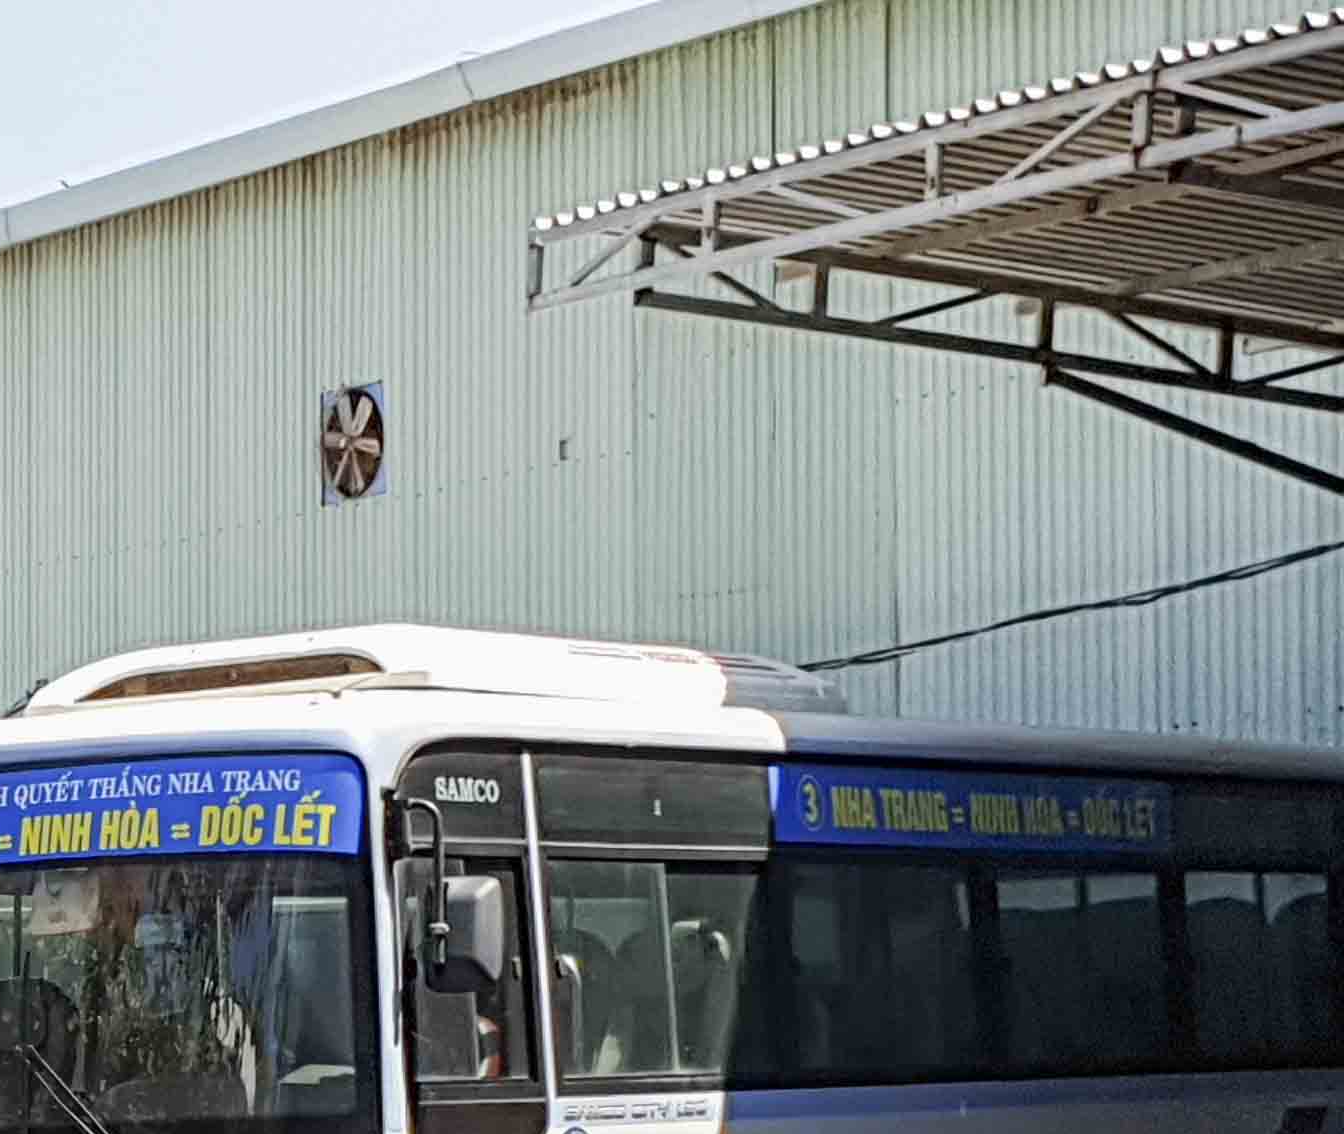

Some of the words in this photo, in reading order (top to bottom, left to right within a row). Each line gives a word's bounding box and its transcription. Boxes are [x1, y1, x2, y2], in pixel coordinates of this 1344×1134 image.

[14, 771, 83, 809] QUYẾT
[89, 765, 161, 800] THẮNG
[167, 771, 215, 794] NHA
[221, 769, 301, 793] TRANG
[434, 776, 500, 803] SAMCO
[802, 783, 818, 823] 3
[831, 786, 877, 828] NHA
[880, 789, 948, 832] TRANG
[19, 812, 93, 856] NINH
[99, 800, 161, 850] HÒA
[198, 789, 265, 847] DỐC
[273, 789, 337, 847] LẾT
